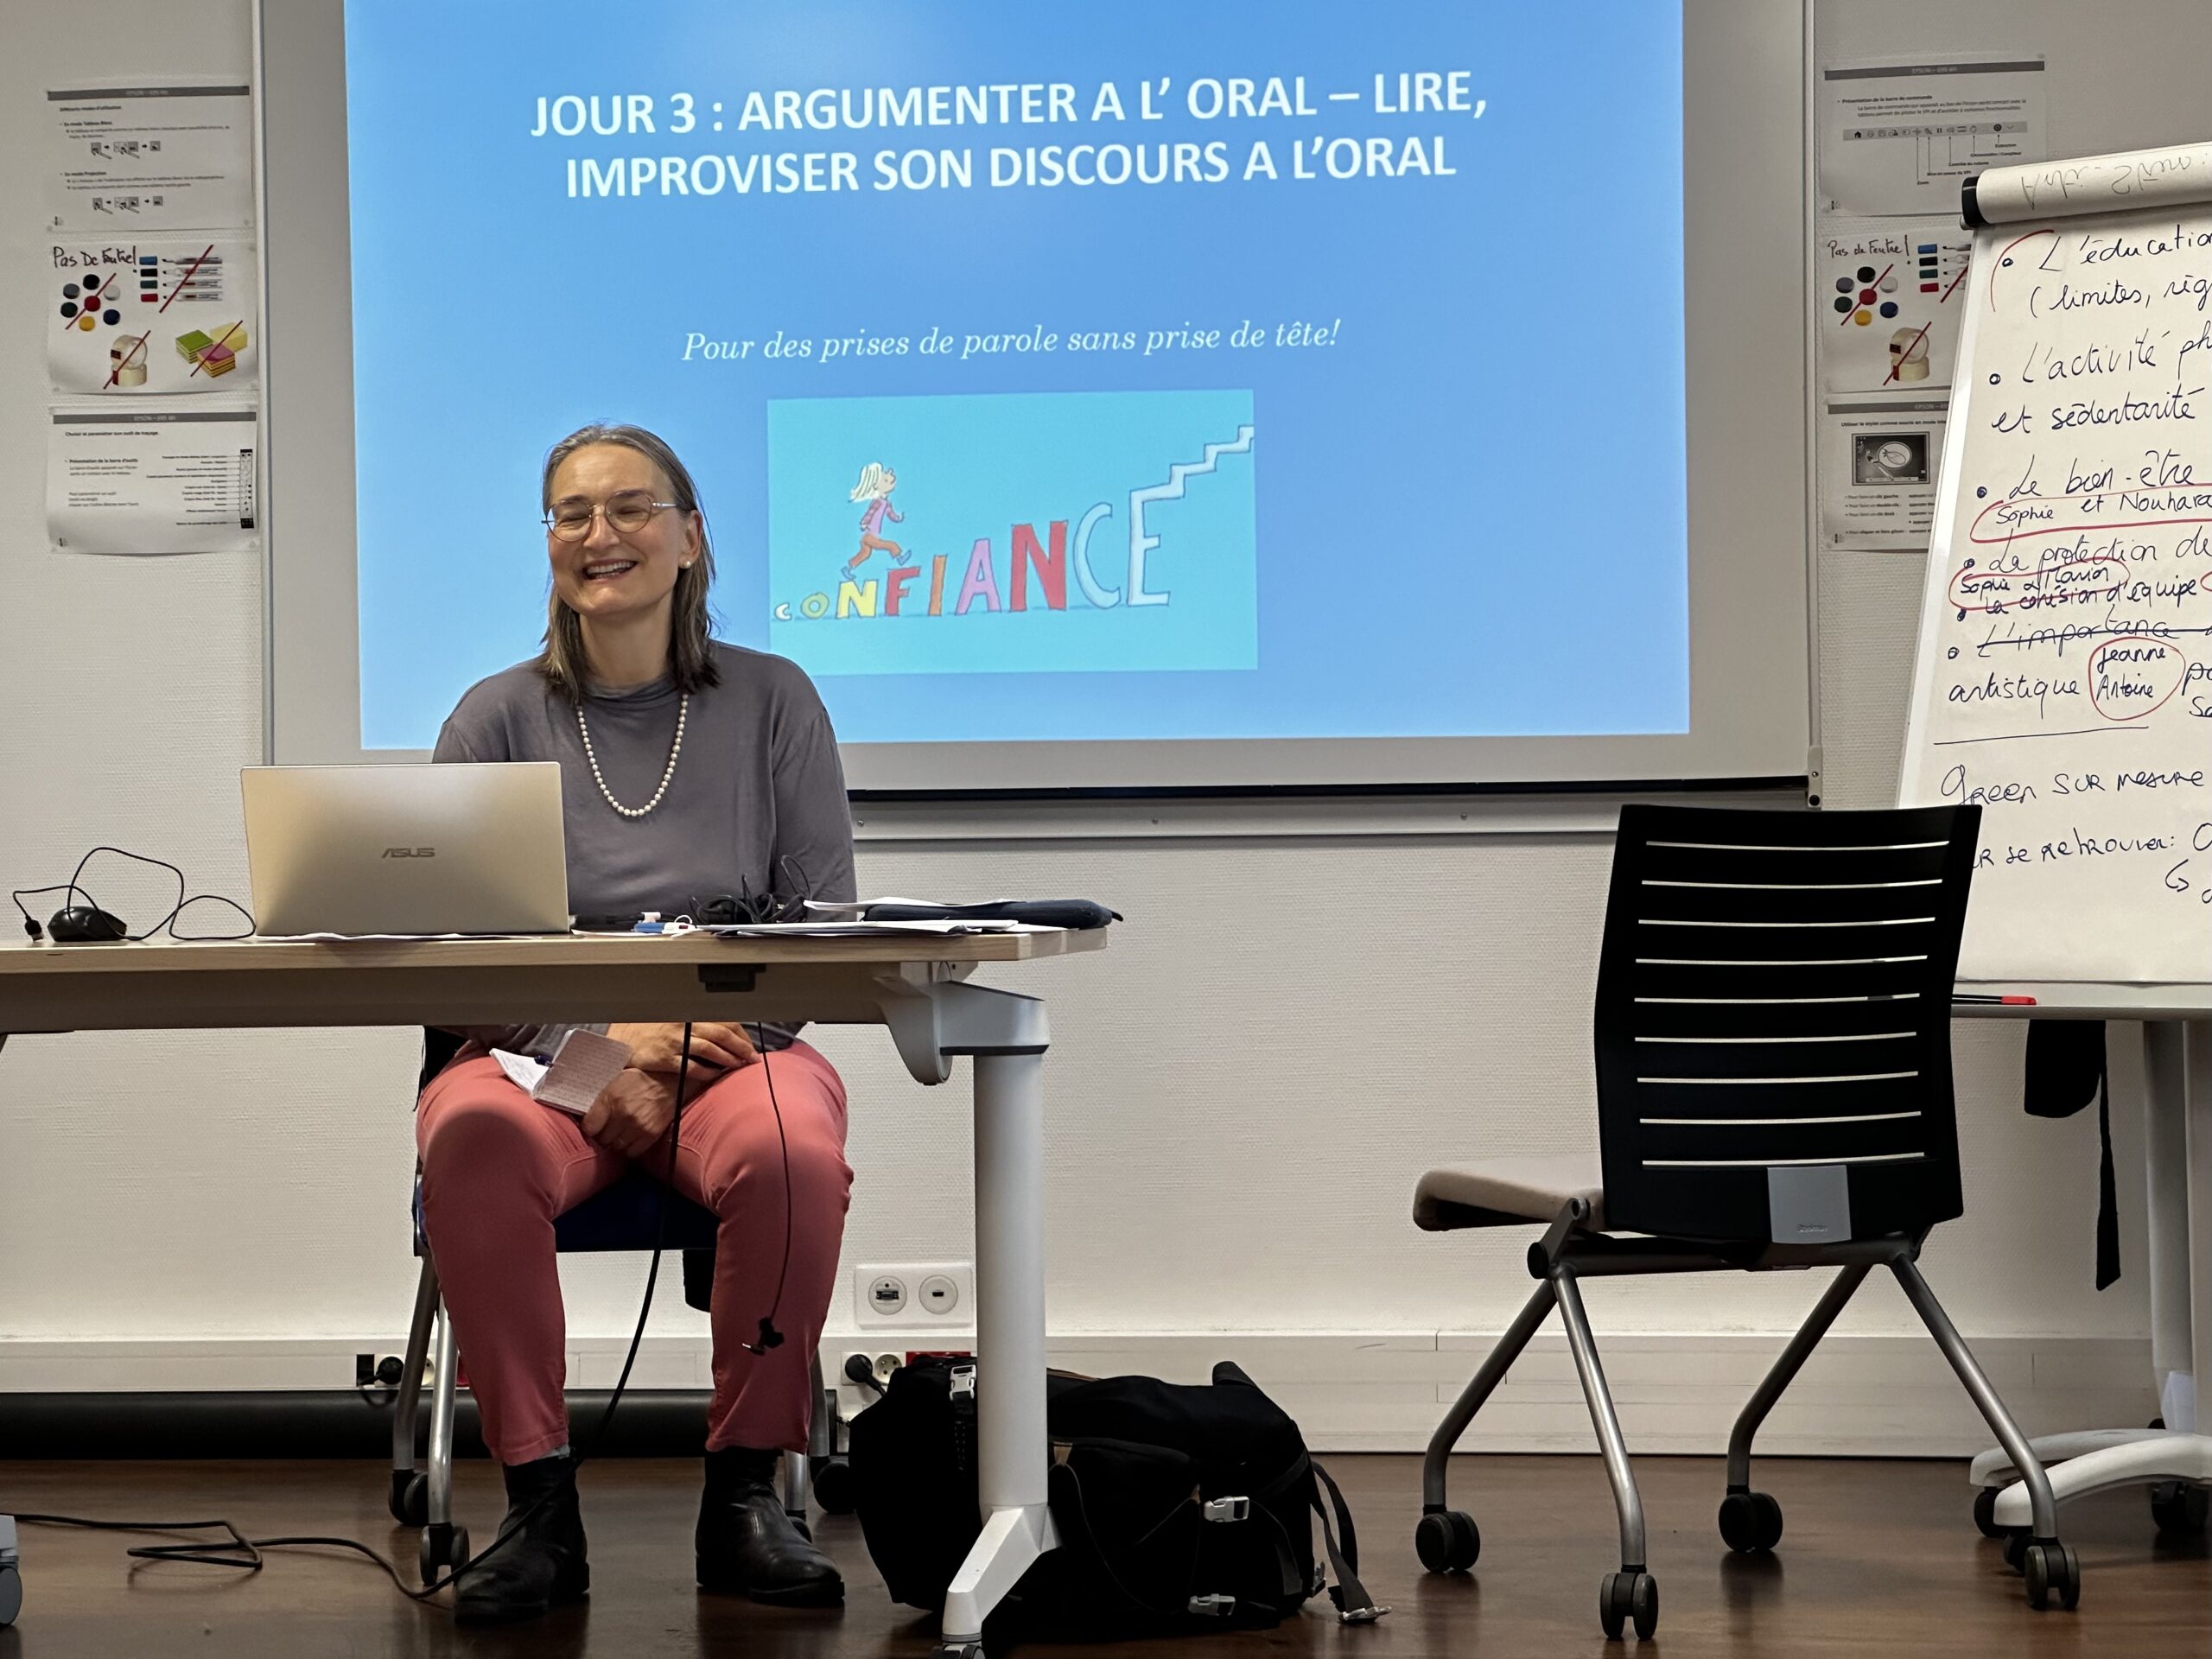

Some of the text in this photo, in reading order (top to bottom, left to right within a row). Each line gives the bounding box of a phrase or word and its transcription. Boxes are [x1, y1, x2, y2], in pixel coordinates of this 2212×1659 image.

[530, 93, 656, 137] JOUR
[670, 92, 696, 134] 3
[712, 101, 723, 131] :
[737, 83, 1078, 131] ARGUMENTER
[1090, 82, 1126, 122] A
[1187, 76, 1318, 120] ORAL
[1375, 71, 1487, 119] LIRE,
[566, 151, 861, 198] IMPROVISER
[874, 149, 972, 191] SON
[990, 141, 1230, 188] DISCOURS
[1243, 140, 1278, 181] A
[54, 246, 78, 268] Pas
[1827, 239, 1848, 258] Pas
[1854, 244, 1866, 255] de
[681, 318, 1342, 363] Pour des prises de parole sans prise de tête!
[1991, 404, 2033, 433] et
[2009, 454, 2043, 499] Le
[1996, 505, 2055, 528] Sophie
[2081, 494, 2104, 512] et
[774, 482, 1185, 620] CONFIANCE
[2037, 534, 2157, 591] protection
[1961, 574, 2011, 601] Sophie
[2096, 646, 2166, 674] Jeanne
[1948, 671, 2081, 719] artistique
[2096, 673, 2154, 701] Antoine
[381, 847, 435, 859] ASUS
